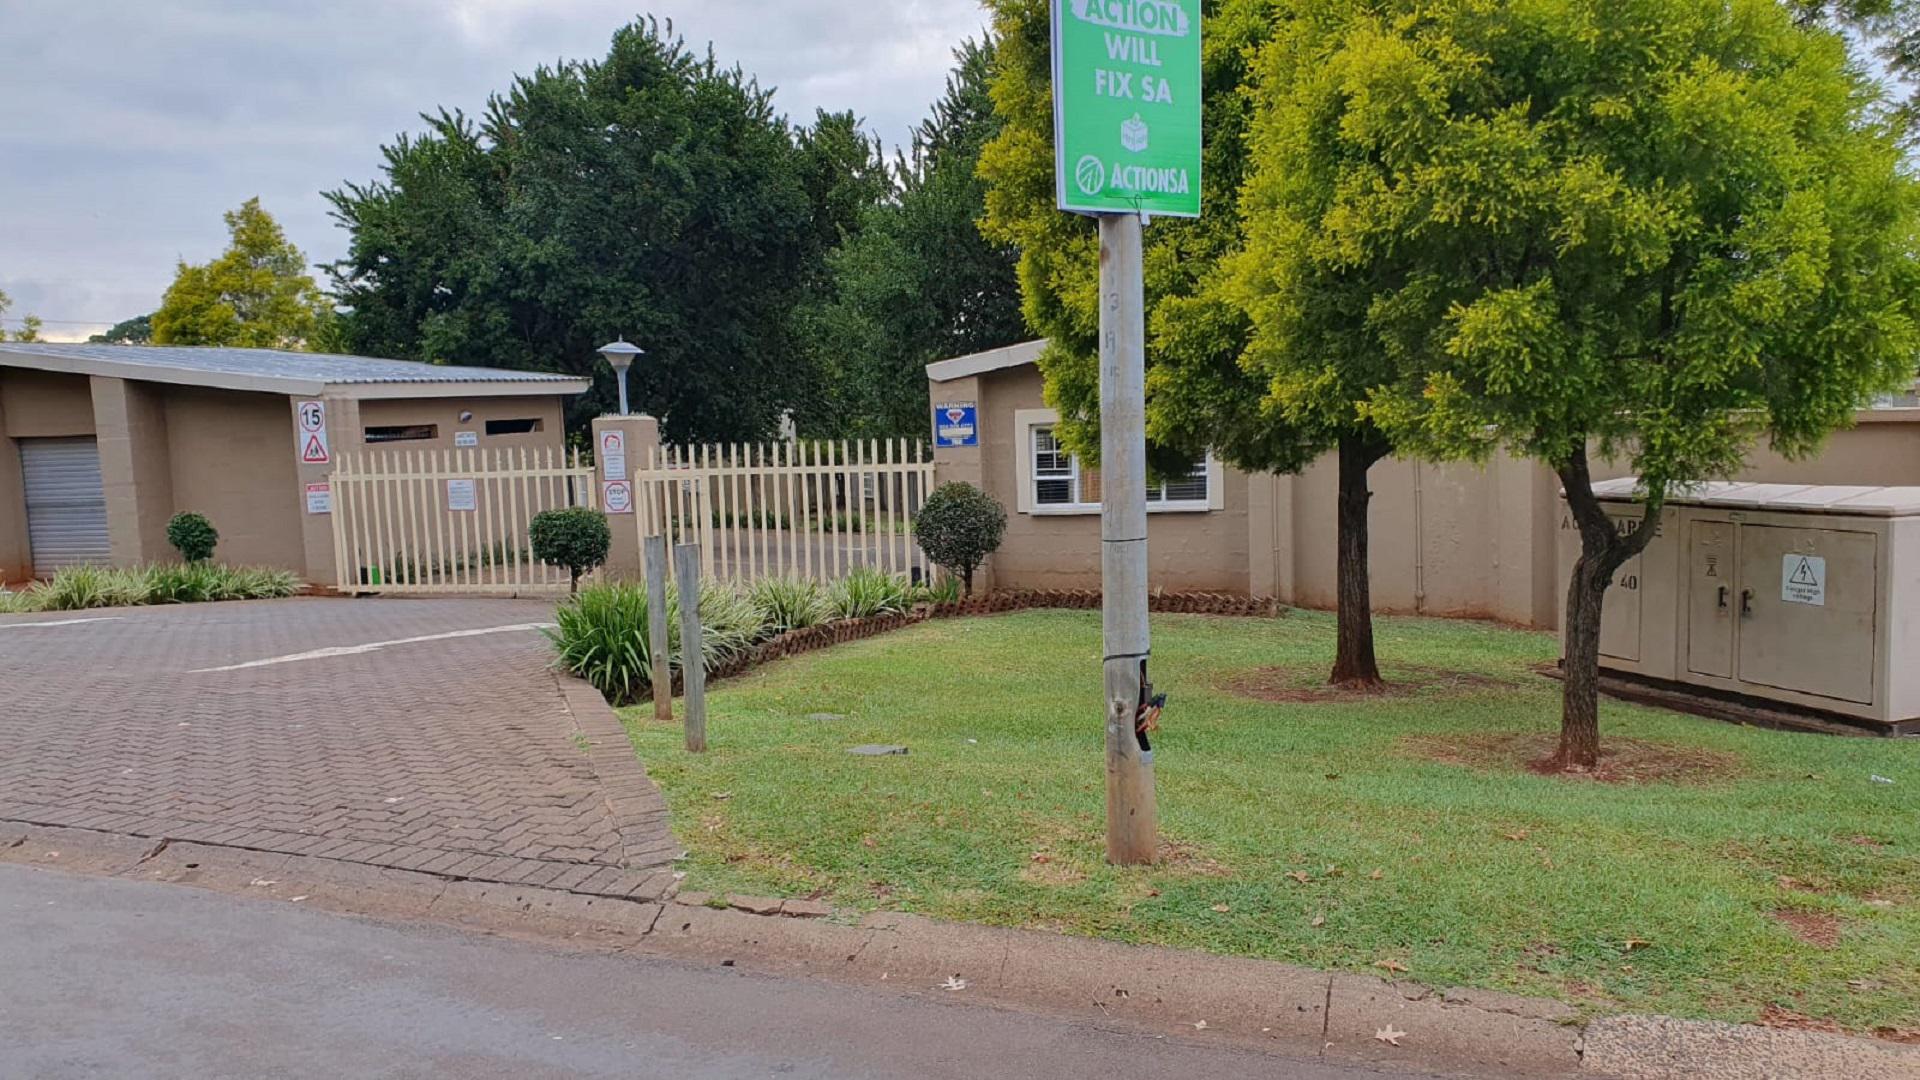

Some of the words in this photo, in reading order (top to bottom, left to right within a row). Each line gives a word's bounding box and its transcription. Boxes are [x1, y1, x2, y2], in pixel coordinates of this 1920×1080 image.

[1085, 0, 1178, 31] ACTION
[1104, 32, 1162, 66] WILL
[1095, 68, 1134, 98] FIX
[1141, 77, 1172, 104] SA
[1110, 162, 1189, 194] ACTIONSA
[303, 409, 320, 426] 15
[1620, 574, 1638, 590] 40
